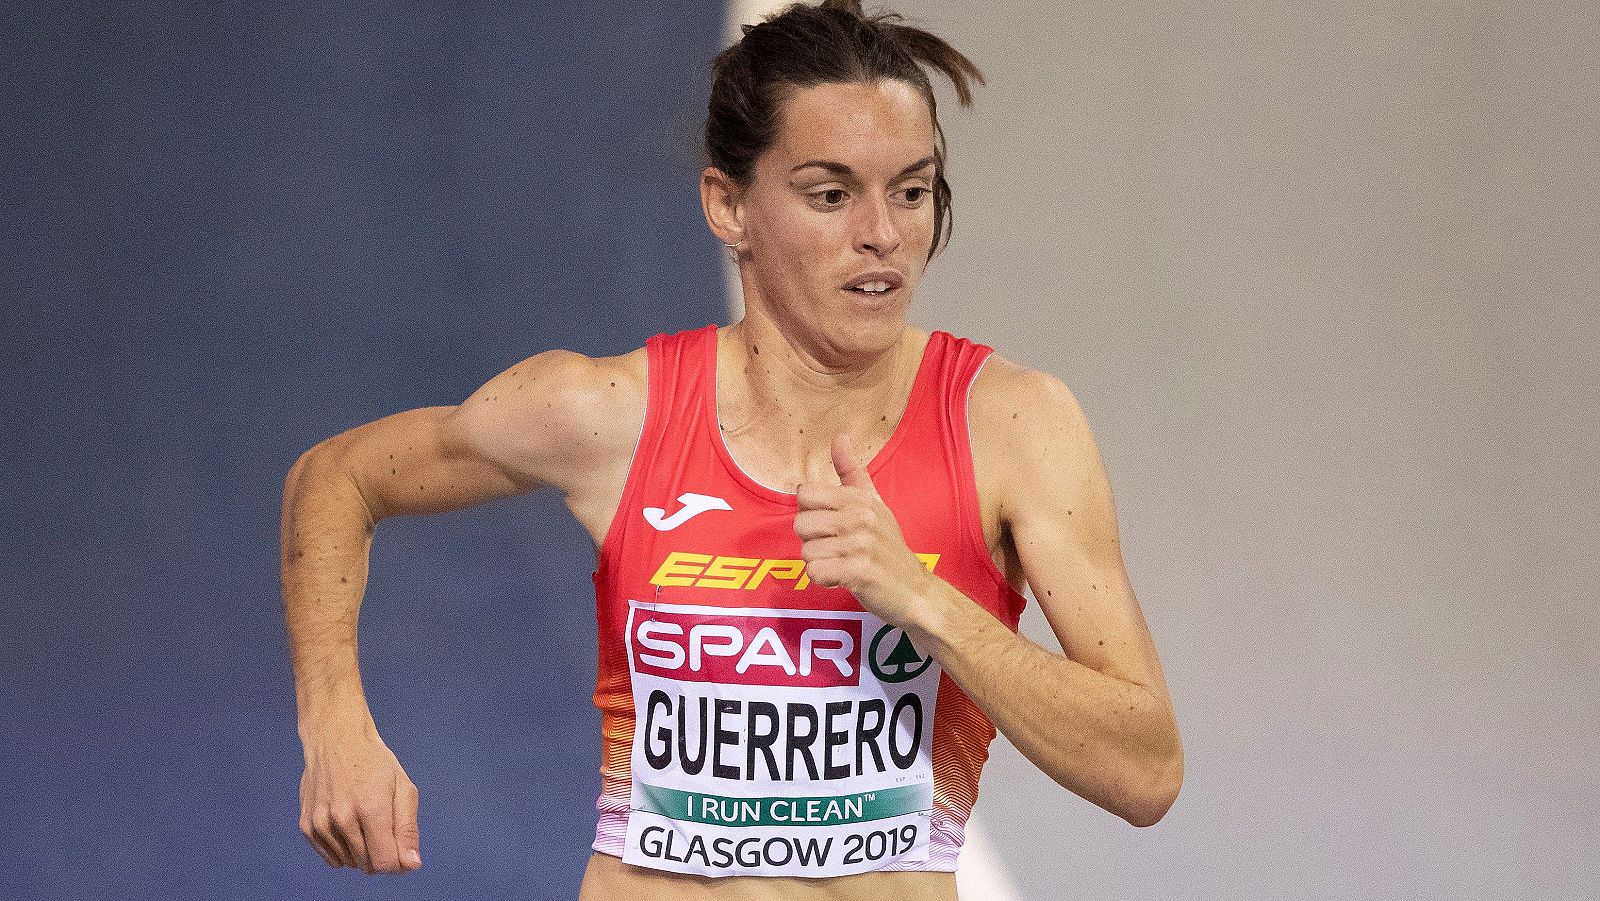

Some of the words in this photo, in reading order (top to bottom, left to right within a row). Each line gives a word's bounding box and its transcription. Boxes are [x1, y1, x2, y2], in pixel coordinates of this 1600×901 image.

[649, 551, 941, 590] ESP
[636, 620, 854, 677] SPAR
[644, 689, 923, 781] GUERRERO
[687, 796, 693, 817] I
[702, 797, 761, 822] RUN
[639, 825, 834, 869] GLASGOW
[842, 824, 918, 866] 2019
